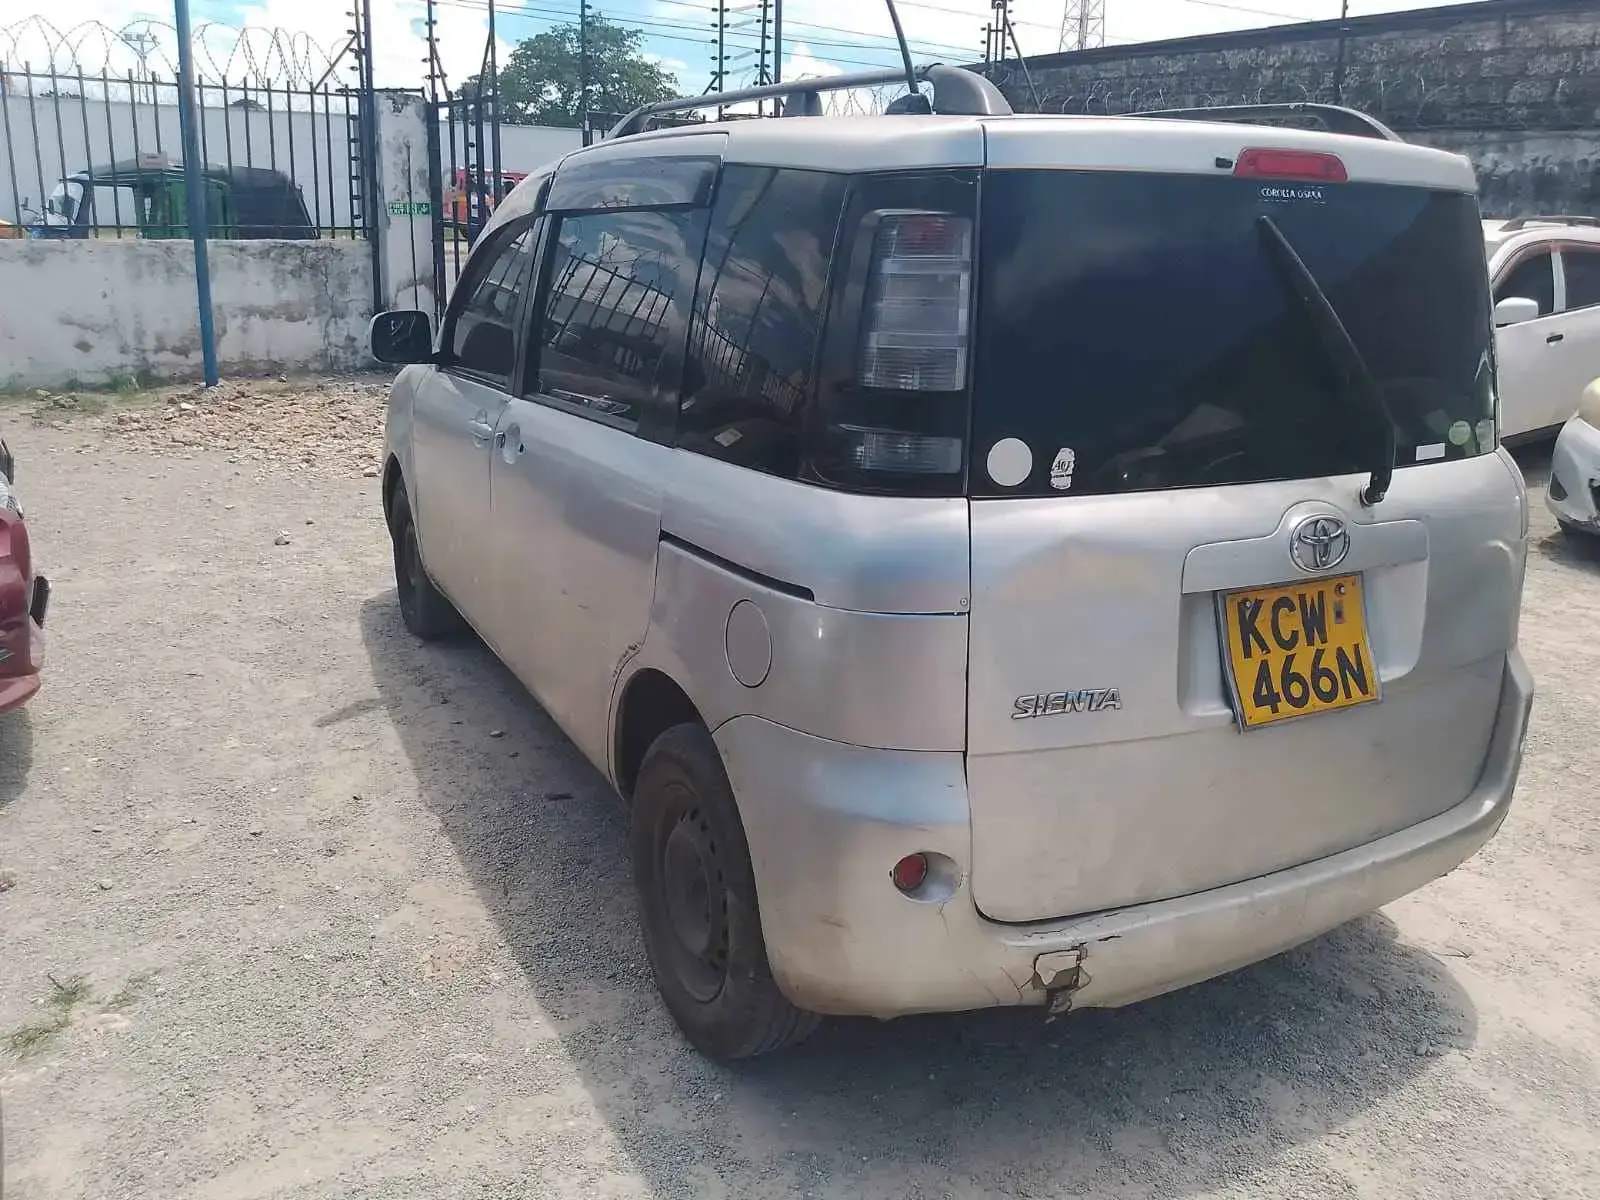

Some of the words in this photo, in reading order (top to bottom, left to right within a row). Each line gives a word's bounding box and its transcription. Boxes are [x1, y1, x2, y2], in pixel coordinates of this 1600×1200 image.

[1237, 590, 1328, 659] KCW
[1011, 688, 1121, 719] SIENTA
[1253, 643, 1369, 714] 466N
